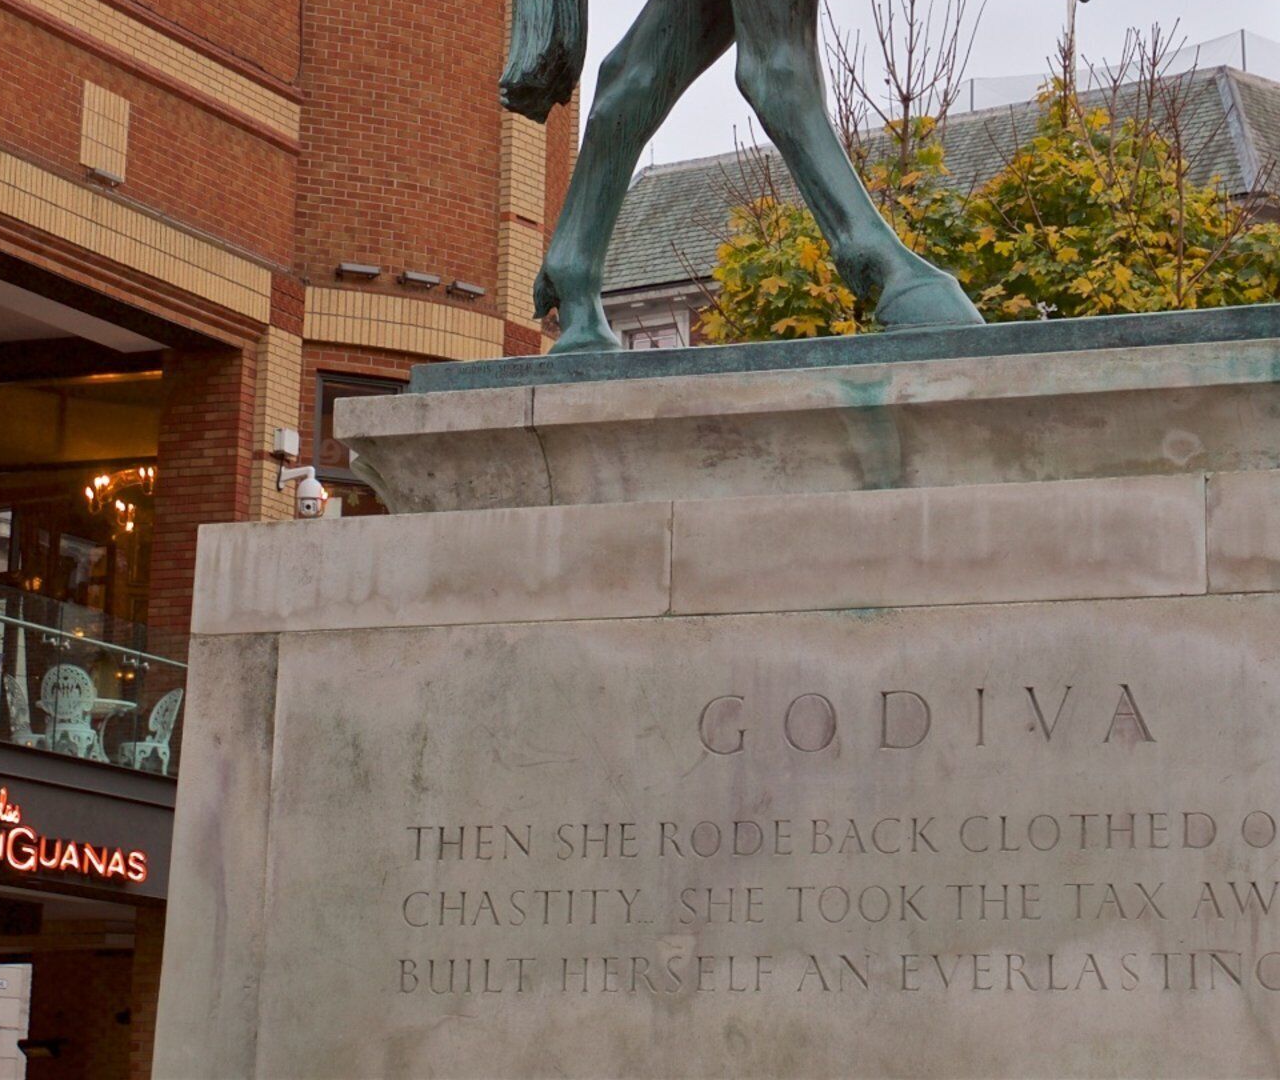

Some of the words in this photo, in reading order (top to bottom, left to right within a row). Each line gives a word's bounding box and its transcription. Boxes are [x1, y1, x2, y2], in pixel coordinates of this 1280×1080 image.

[698, 684, 1157, 755] GODIVA
[406, 825, 532, 861] THEN
[556, 823, 640, 861] SHE
[657, 821, 793, 860] RODE
[809, 817, 940, 857] BACK
[958, 810, 1218, 853] CLOTHED
[678, 886, 765, 925] SHE
[786, 884, 928, 924] TOOK
[946, 882, 1042, 922] THE
[1064, 881, 1168, 921] TAX
[397, 956, 536, 996] BUILT
[560, 954, 773, 995] HERSELF
[797, 953, 872, 993] AN
